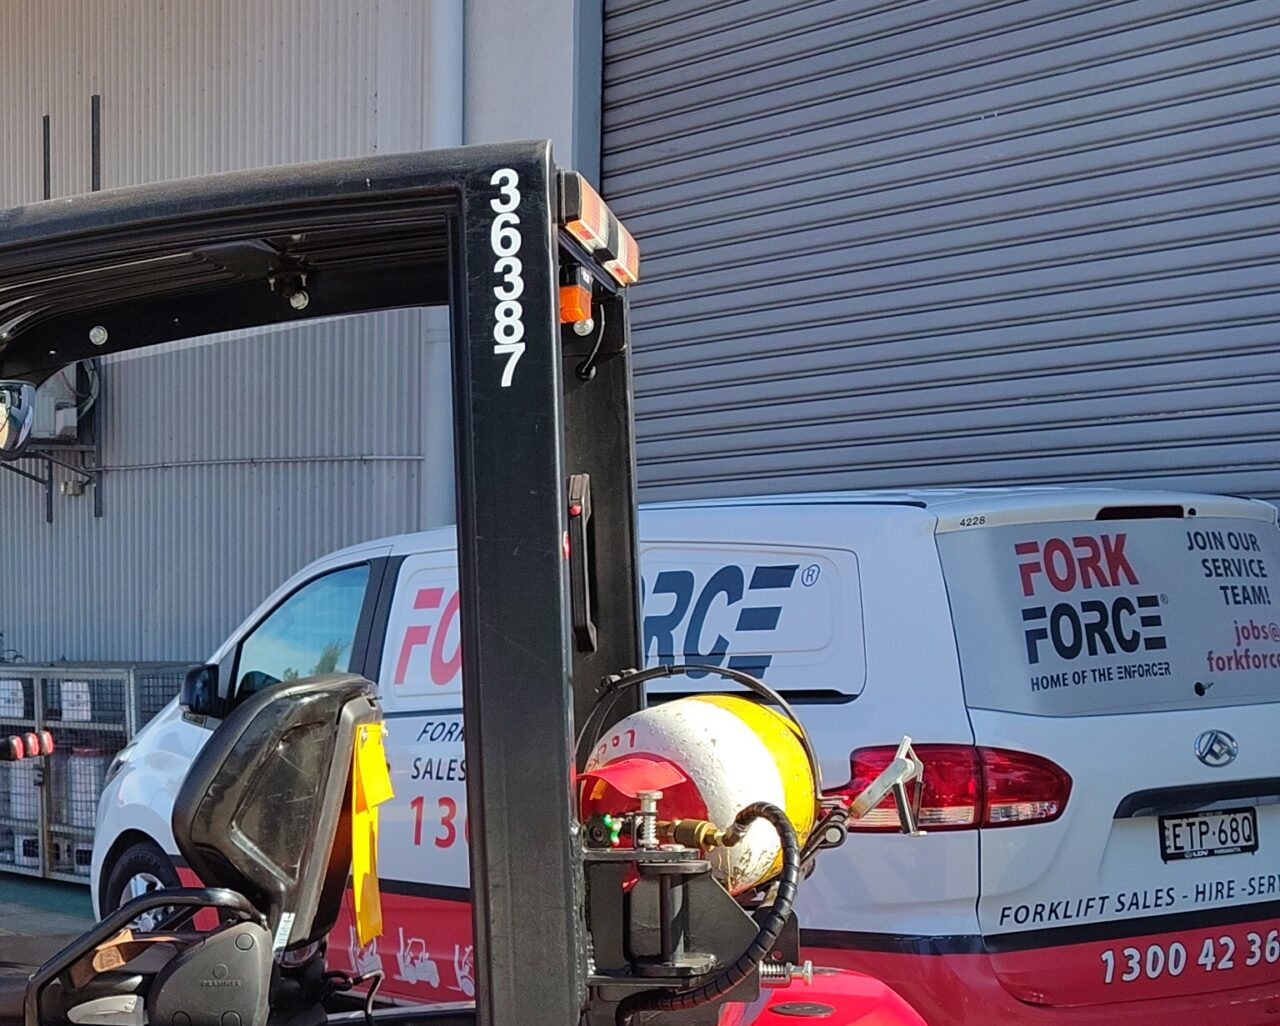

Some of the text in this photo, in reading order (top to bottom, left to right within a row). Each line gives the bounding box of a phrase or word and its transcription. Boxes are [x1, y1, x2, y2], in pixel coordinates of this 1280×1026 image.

[490, 168, 526, 388] 36387
[960, 516, 986, 527] 4228
[1186, 531, 1261, 552] JOIN OUR
[1014, 533, 1140, 597] FORK
[1202, 558, 1268, 578] SERVICE
[1219, 585, 1271, 605] TEAM!
[1022, 595, 1167, 664] FORCE
[1031, 661, 1171, 692] HOME OF THE ENFORCER
[411, 796, 471, 849] 13
[999, 895, 1110, 927] FORKLIFT
[1115, 886, 1176, 912] SALES
[1194, 879, 1236, 903] HIRE
[1100, 941, 1188, 984] 1300
[1197, 935, 1236, 972] 42
